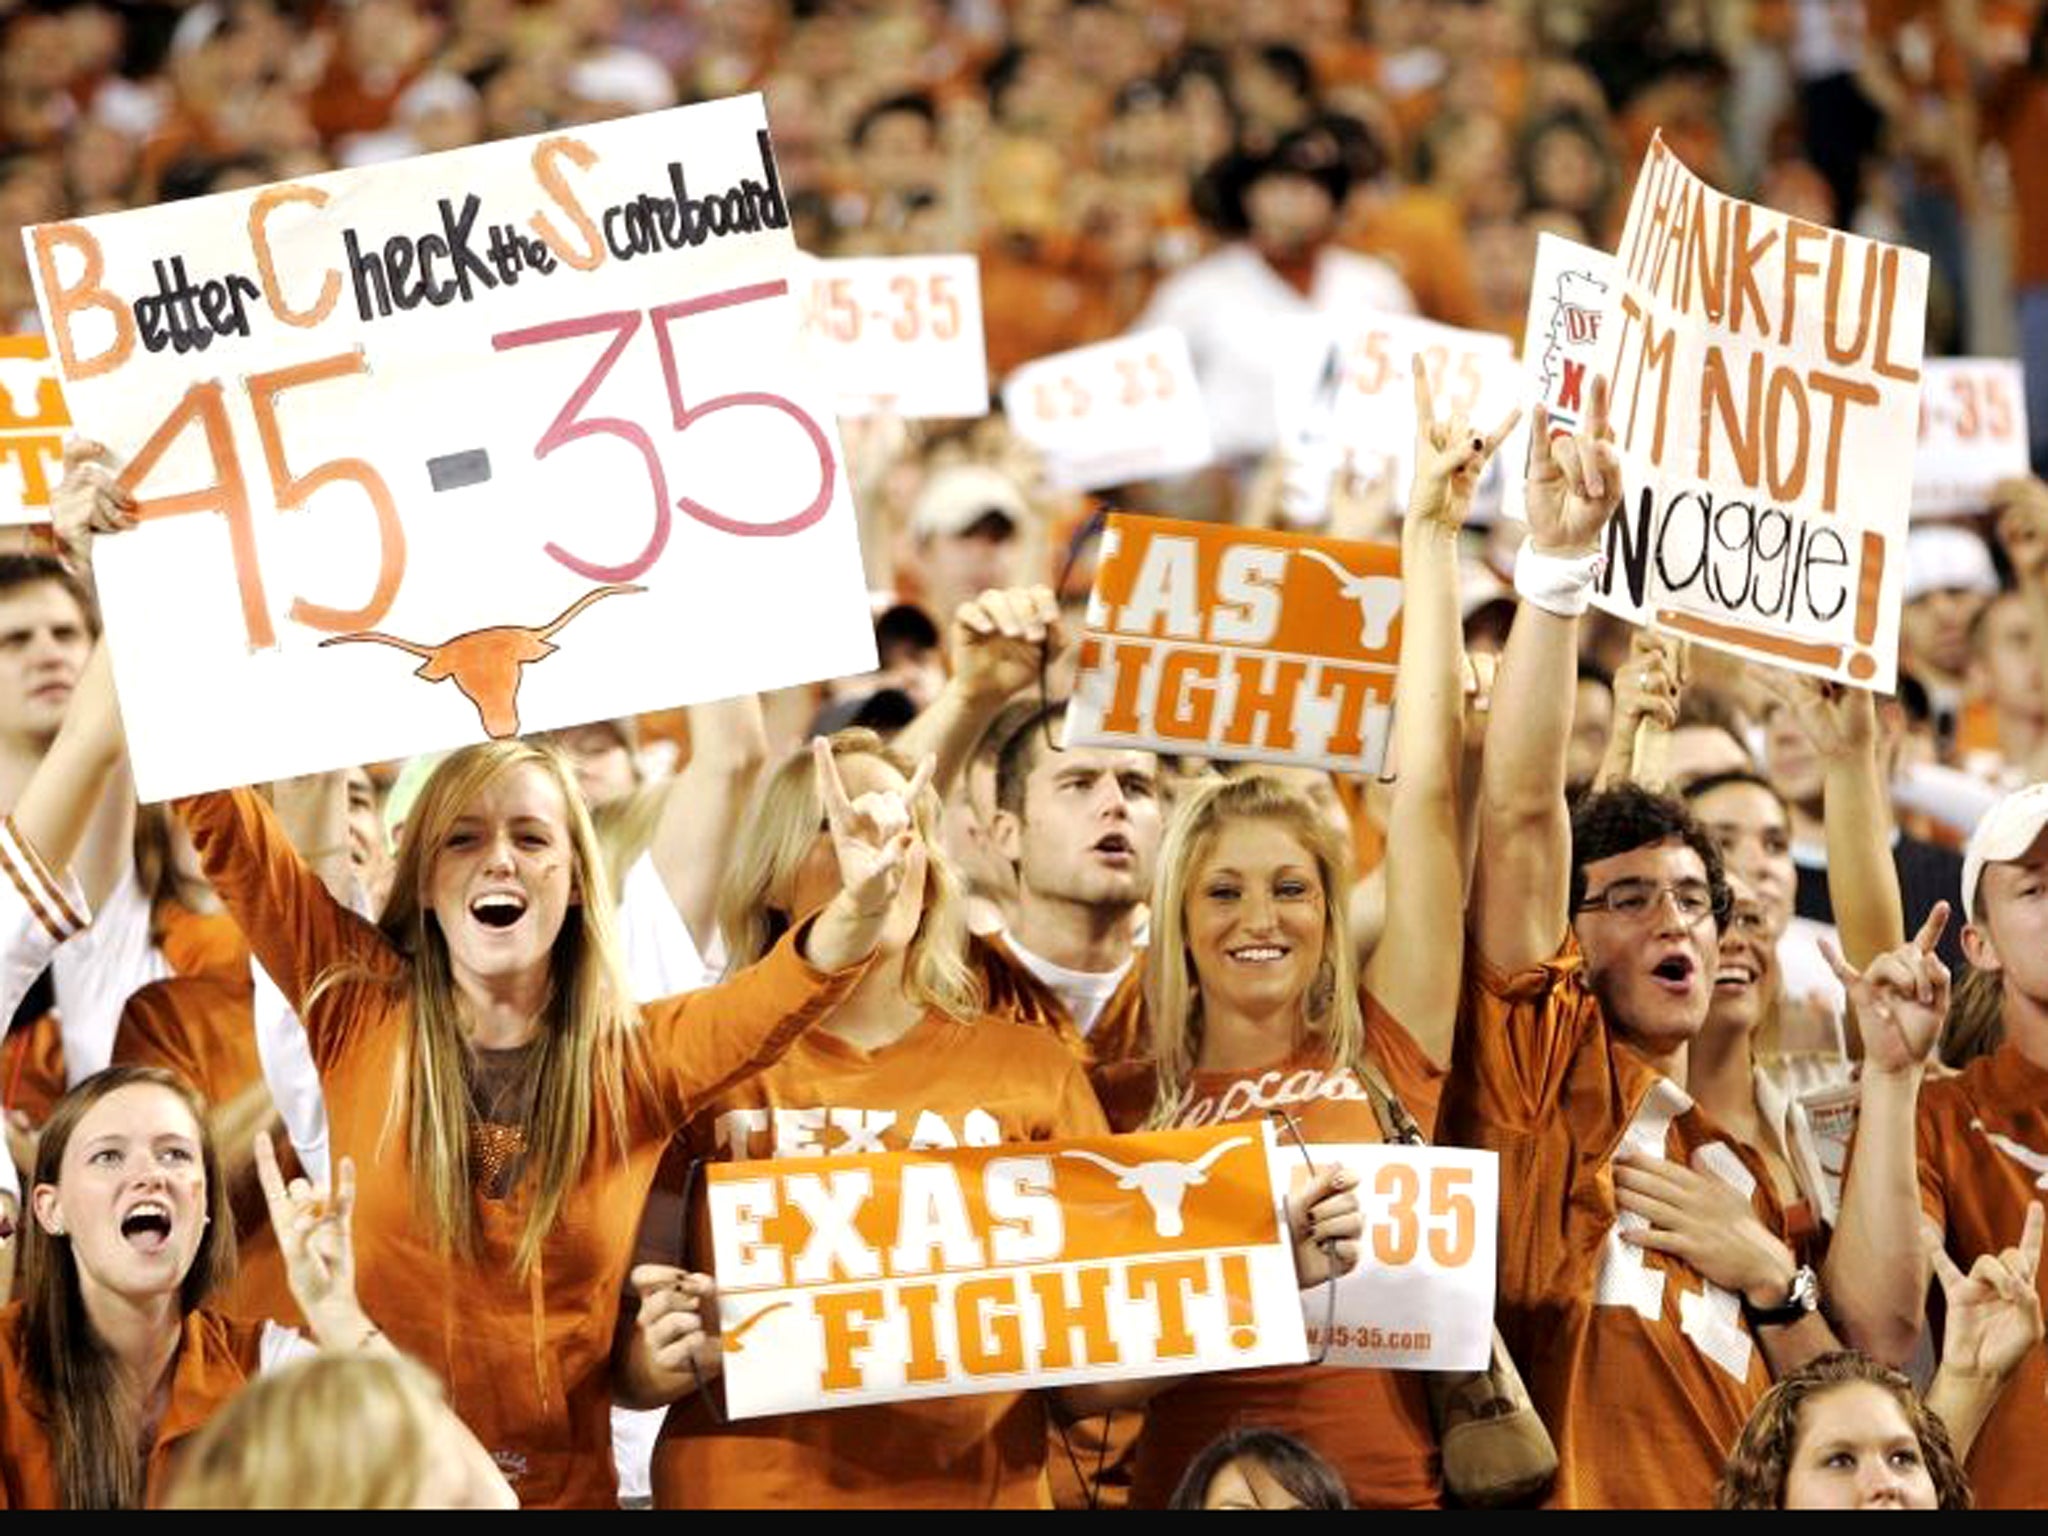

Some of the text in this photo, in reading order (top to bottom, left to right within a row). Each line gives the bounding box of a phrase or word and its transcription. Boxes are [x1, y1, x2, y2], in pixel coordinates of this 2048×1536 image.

[34, 221, 261, 381] Better
[487, 224, 557, 286] the
[528, 129, 789, 271] Scoreboard
[1627, 141, 1920, 383] THANKFUL
[1698, 346, 1880, 513] NOT
[708, 1154, 1067, 1290] EXAS
[813, 1254, 1257, 1392] FIGHT!
